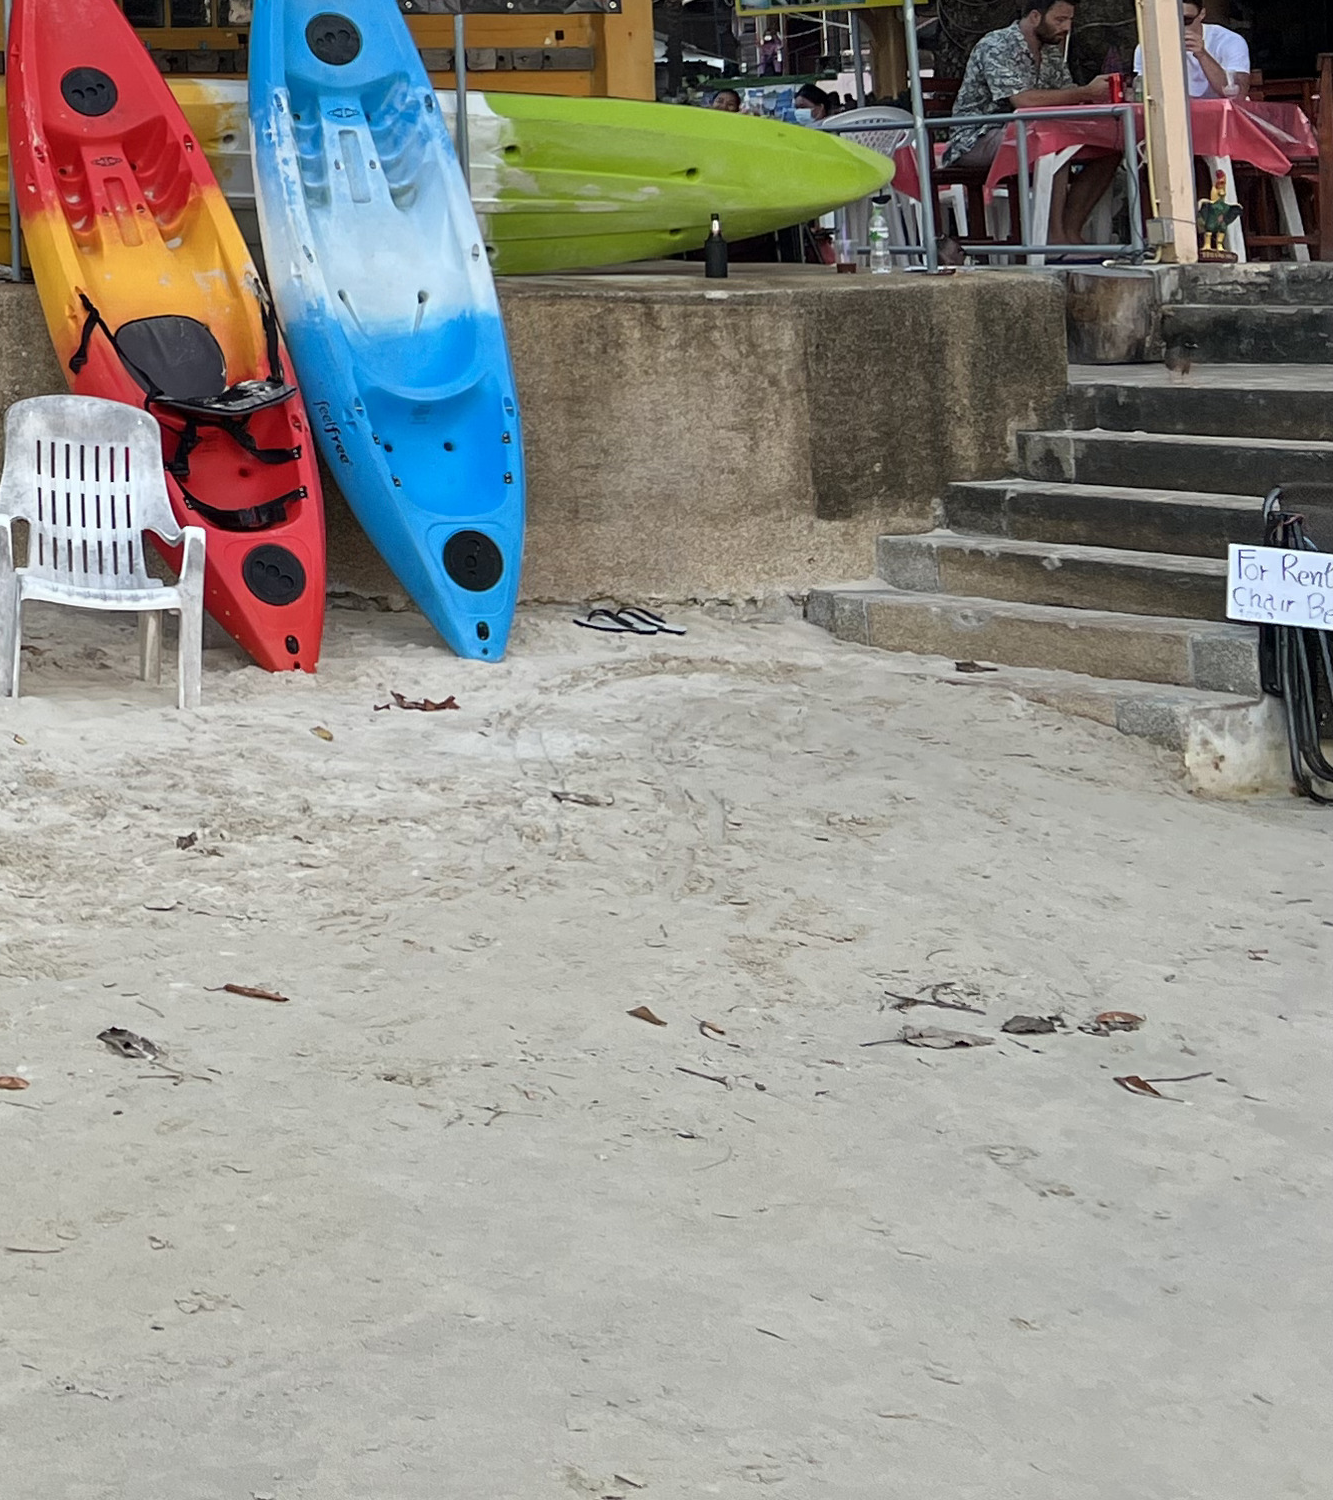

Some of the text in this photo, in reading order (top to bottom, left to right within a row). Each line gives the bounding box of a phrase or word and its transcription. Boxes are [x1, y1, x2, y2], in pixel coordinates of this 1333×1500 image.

[312, 401, 350, 463] feelfree
[1237, 549, 1270, 581] For
[1232, 585, 1296, 613] Chair
